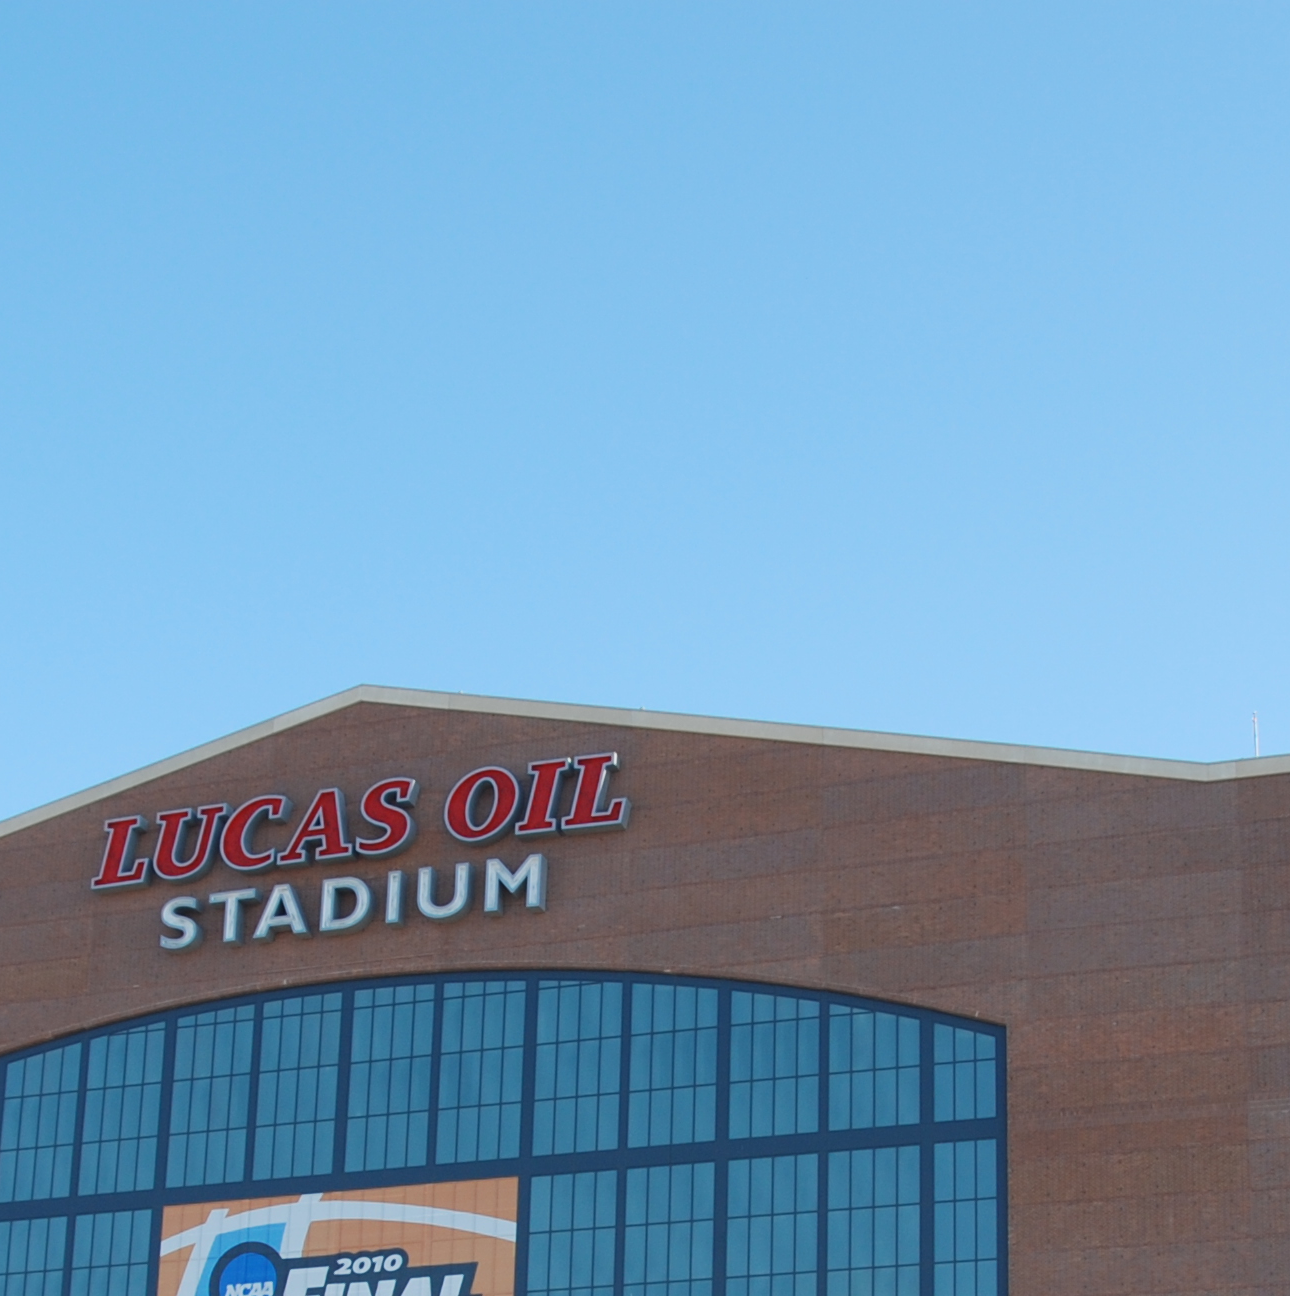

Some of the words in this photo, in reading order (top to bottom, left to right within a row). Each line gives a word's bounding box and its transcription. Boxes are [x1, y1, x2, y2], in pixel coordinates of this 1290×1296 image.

[90, 777, 418, 890] LUCAS
[444, 751, 631, 843] OIL
[159, 853, 547, 951] STADIUM
[333, 1252, 404, 1277] 2010
